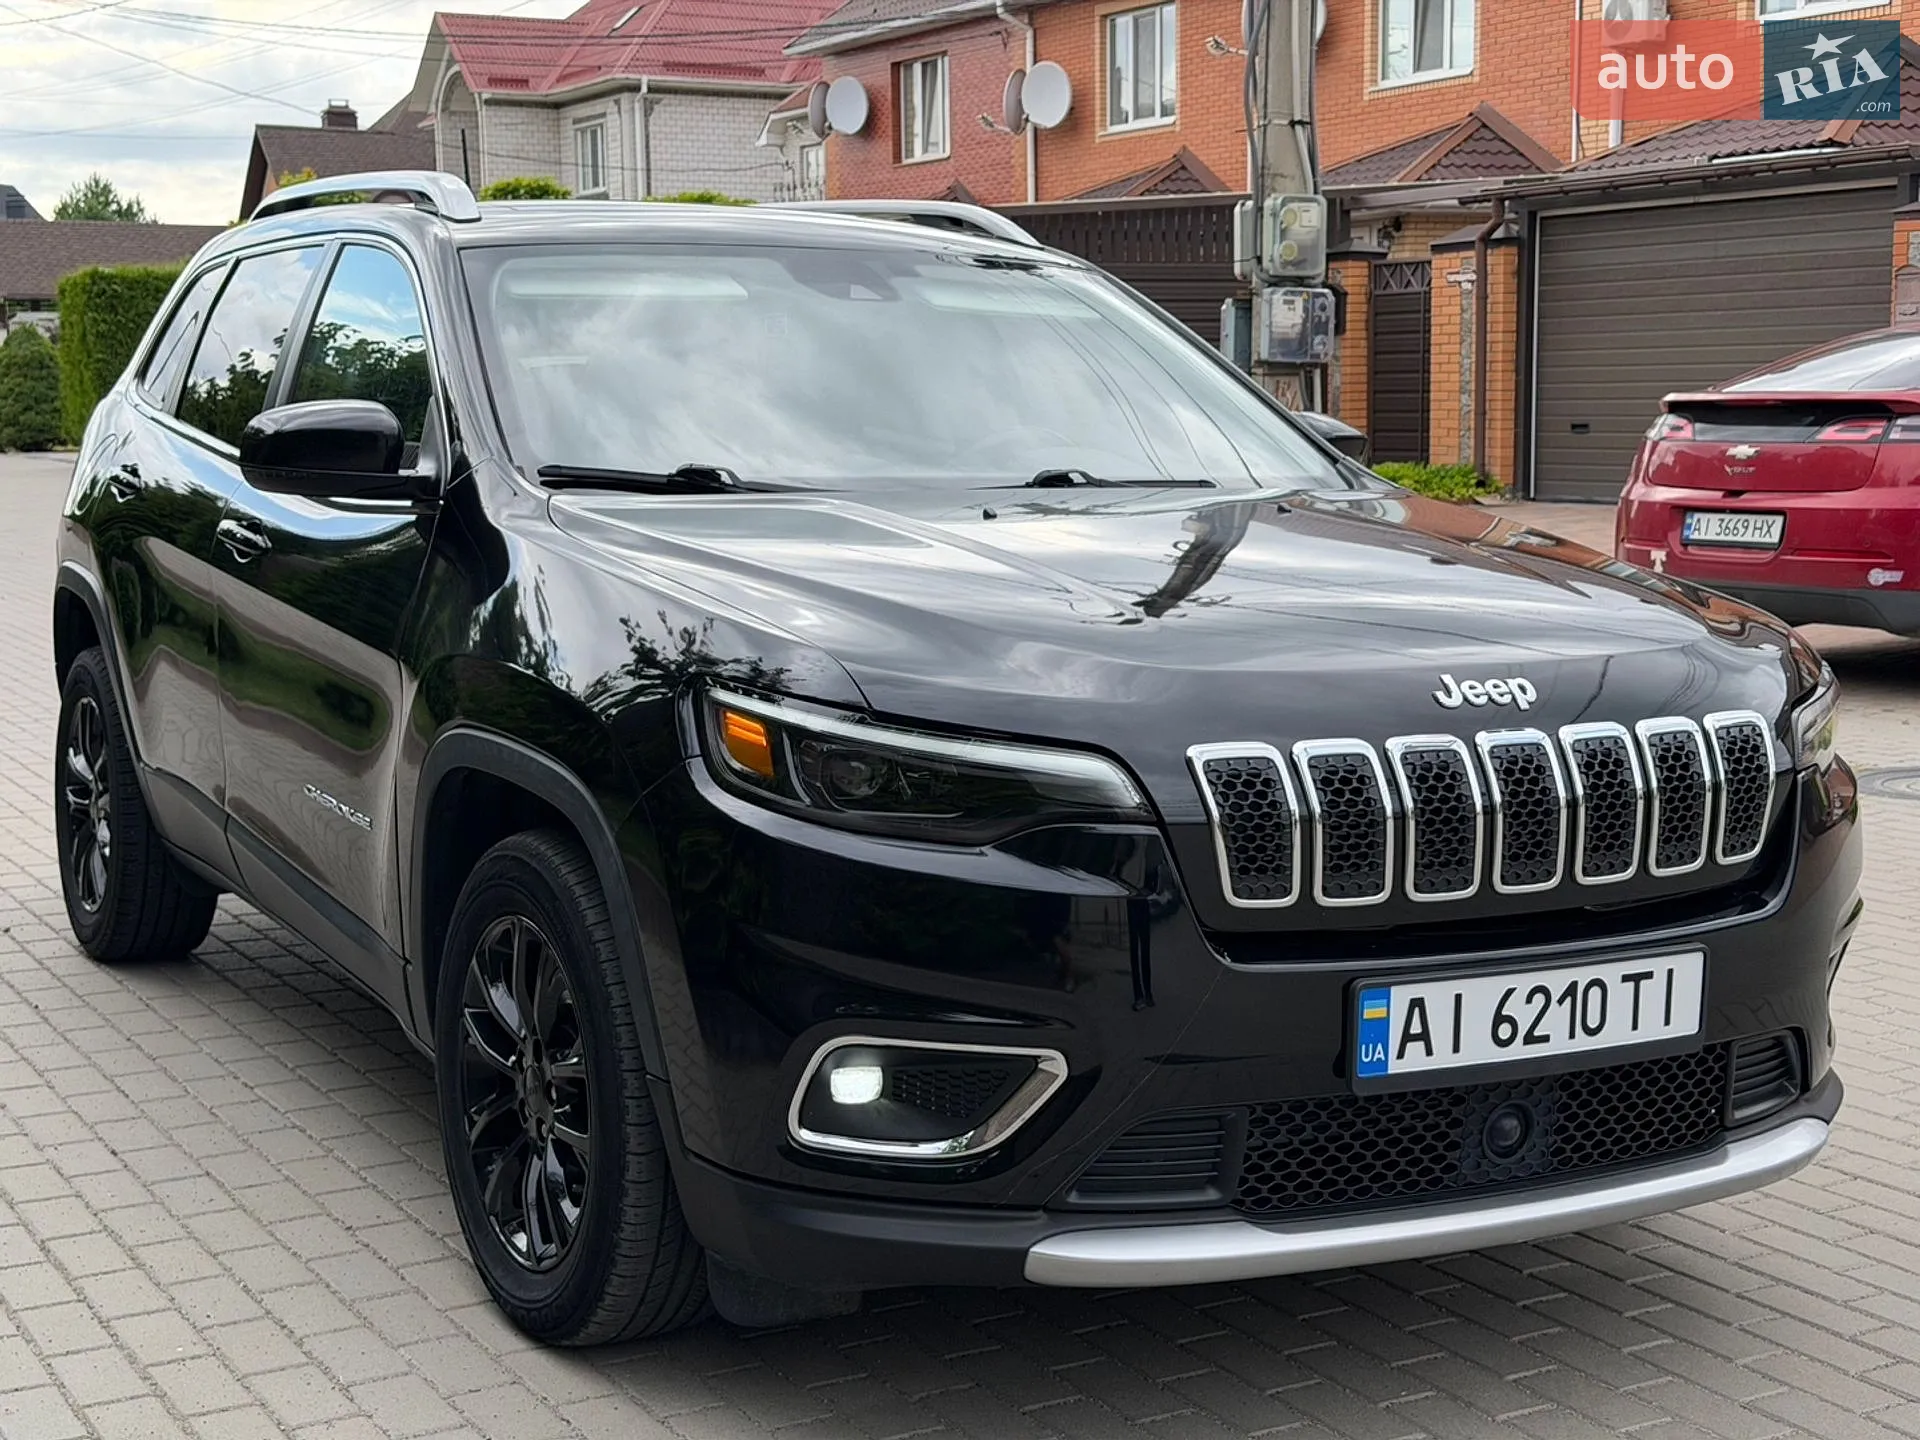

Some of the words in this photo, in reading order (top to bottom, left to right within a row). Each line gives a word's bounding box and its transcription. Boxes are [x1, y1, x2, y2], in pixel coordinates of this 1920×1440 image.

[1692, 517, 1710, 536] AI
[1715, 518, 1750, 538] 3669
[1752, 519, 1776, 539] HX
[1431, 673, 1537, 711] Jeep
[1395, 992, 1463, 1061] AI
[1490, 977, 1609, 1049] 6210
[1621, 967, 1675, 1032] TI
[1361, 1042, 1386, 1063] UA
